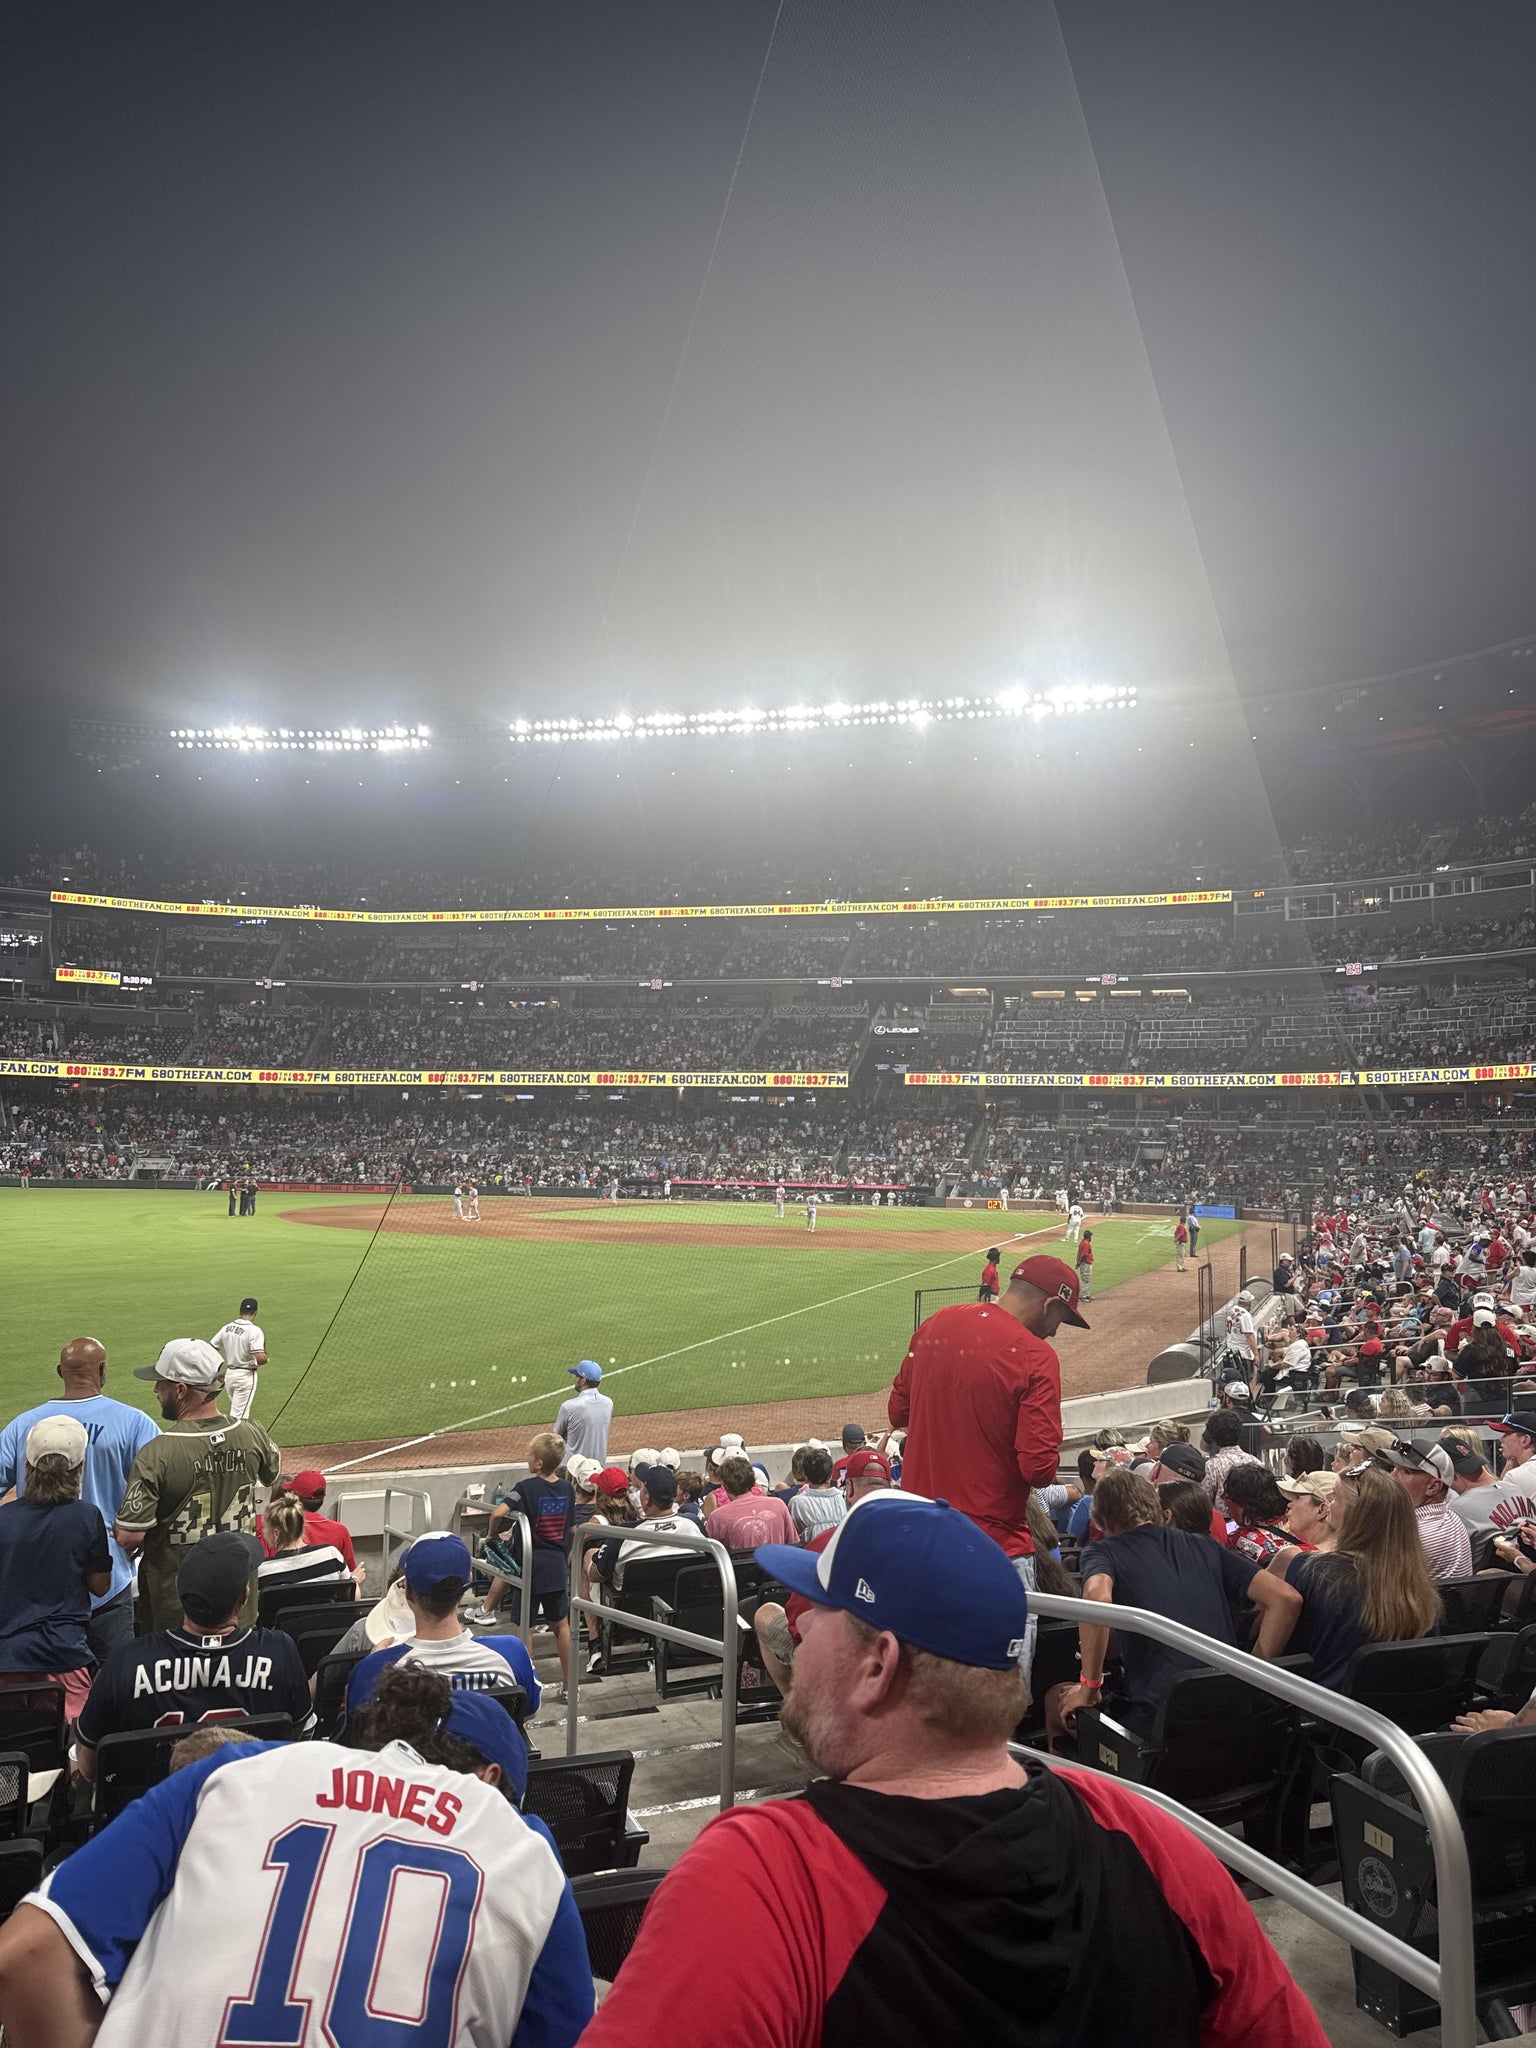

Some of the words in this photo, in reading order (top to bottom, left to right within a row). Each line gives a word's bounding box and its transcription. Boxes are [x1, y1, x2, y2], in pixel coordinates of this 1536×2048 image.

[1346, 963, 1362, 976] 29
[140, 977, 152, 985] PM
[651, 979, 662, 990] 10
[831, 977, 842, 988] 21
[1102, 974, 1116, 985] 25
[67, 1066, 87, 1076] 680
[152, 1069, 252, 1081] 680THEFAN.COM
[259, 1072, 278, 1081] 680
[335, 1073, 422, 1082] 680THEFAN.COM
[500, 1074, 590, 1083] 680THEFAN.COM
[597, 1074, 614, 1083] 680
[672, 1075, 767, 1084] 680THEFAN.COM
[774, 1075, 792, 1085] 680
[909, 1075, 927, 1083] 680
[986, 1076, 1083, 1084] 680THEFAN.COM
[1171, 1076, 1276, 1084] 680THEFAN.COM
[1282, 1075, 1301, 1084] 680
[1367, 1070, 1469, 1082] 680THEFAN.COM
[1476, 1068, 1493, 1078] 680
[234, 1326, 245, 1336] BOY
[134, 1655, 231, 1699] ACUNA
[235, 1655, 274, 1692] JR.
[316, 1767, 463, 1836] JONES
[215, 1818, 485, 2048] 10
